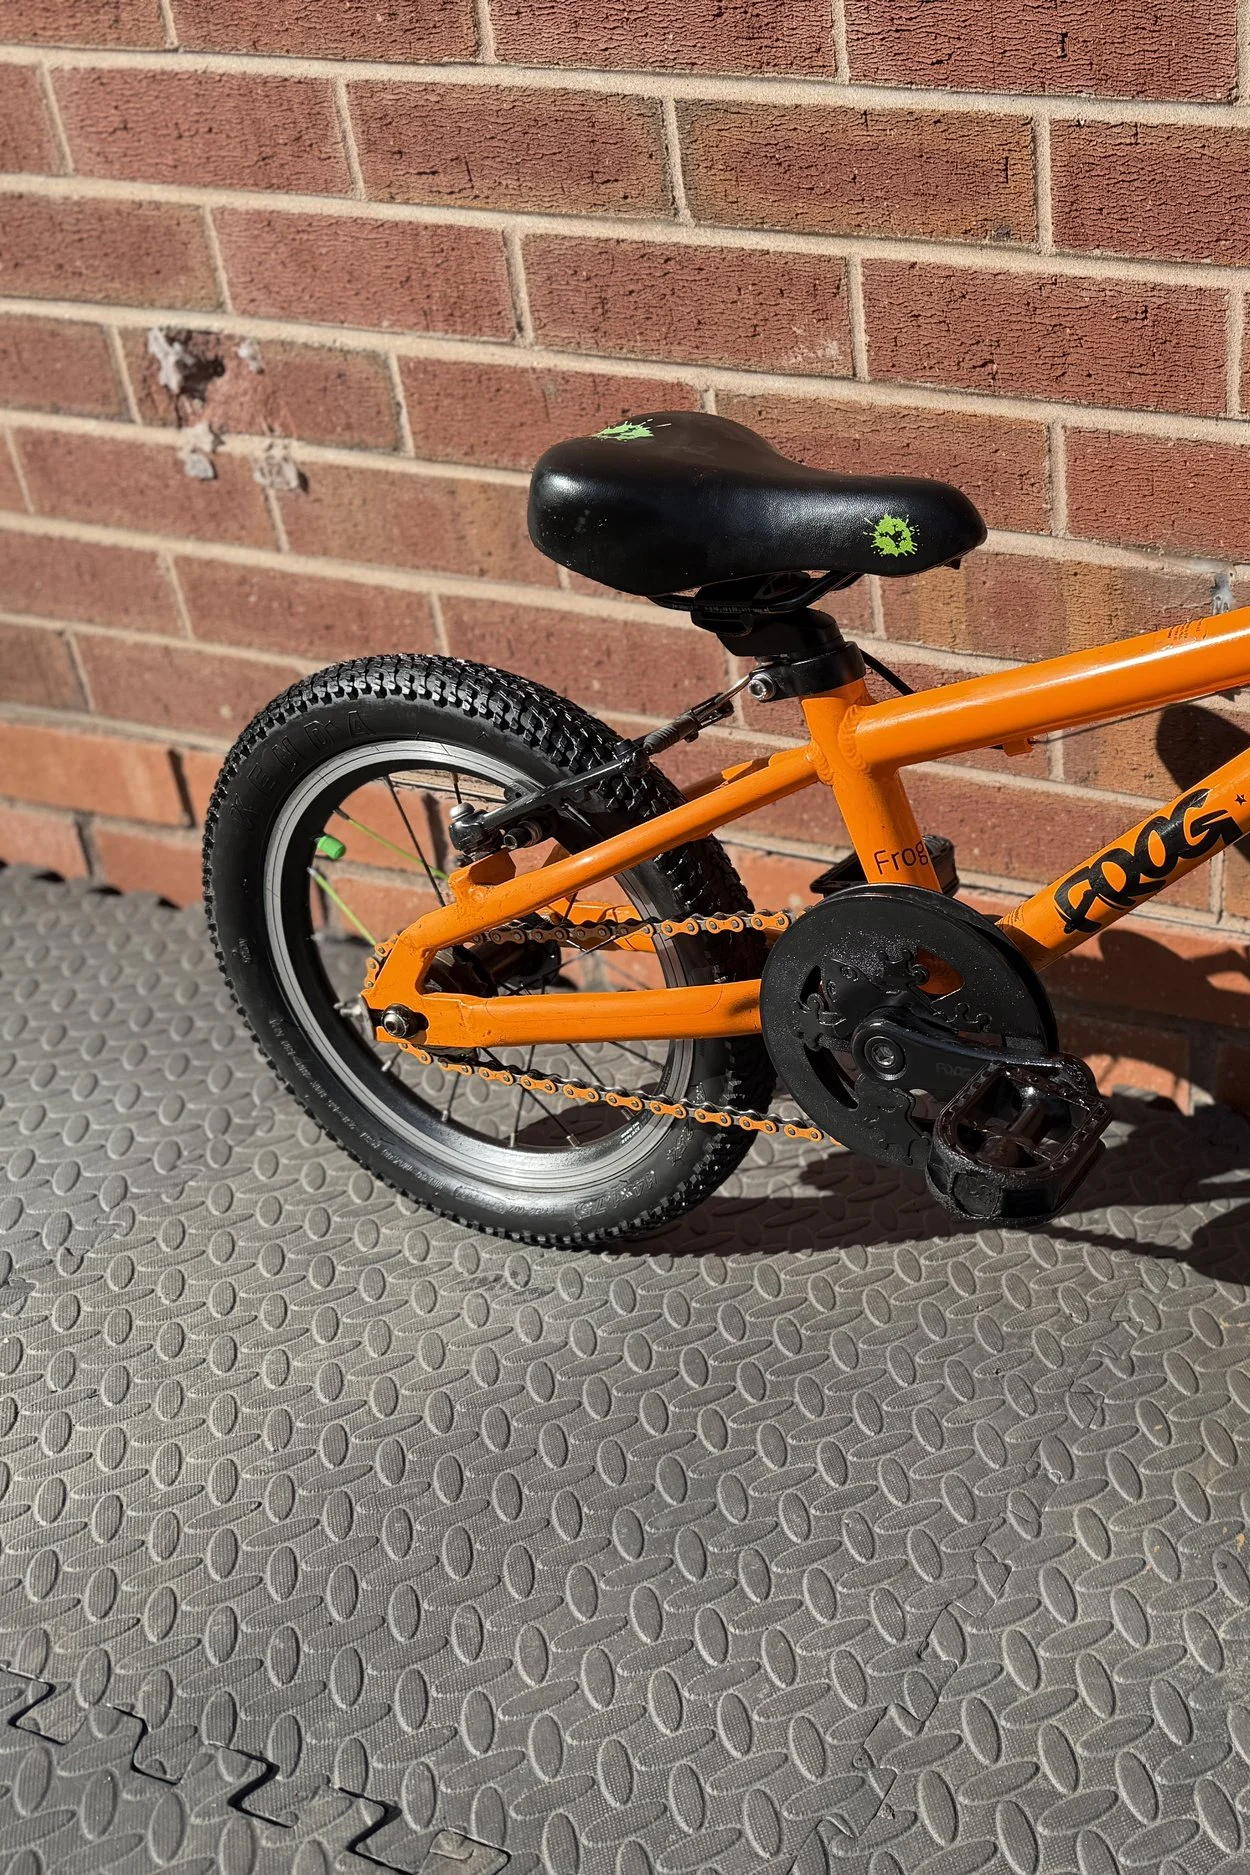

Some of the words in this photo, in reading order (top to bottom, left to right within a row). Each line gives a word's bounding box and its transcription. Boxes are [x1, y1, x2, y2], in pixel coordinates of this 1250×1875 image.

[229, 710, 376, 829] KENDA
[873, 840, 929, 876] Frog
[1053, 787, 1243, 934] FROG
